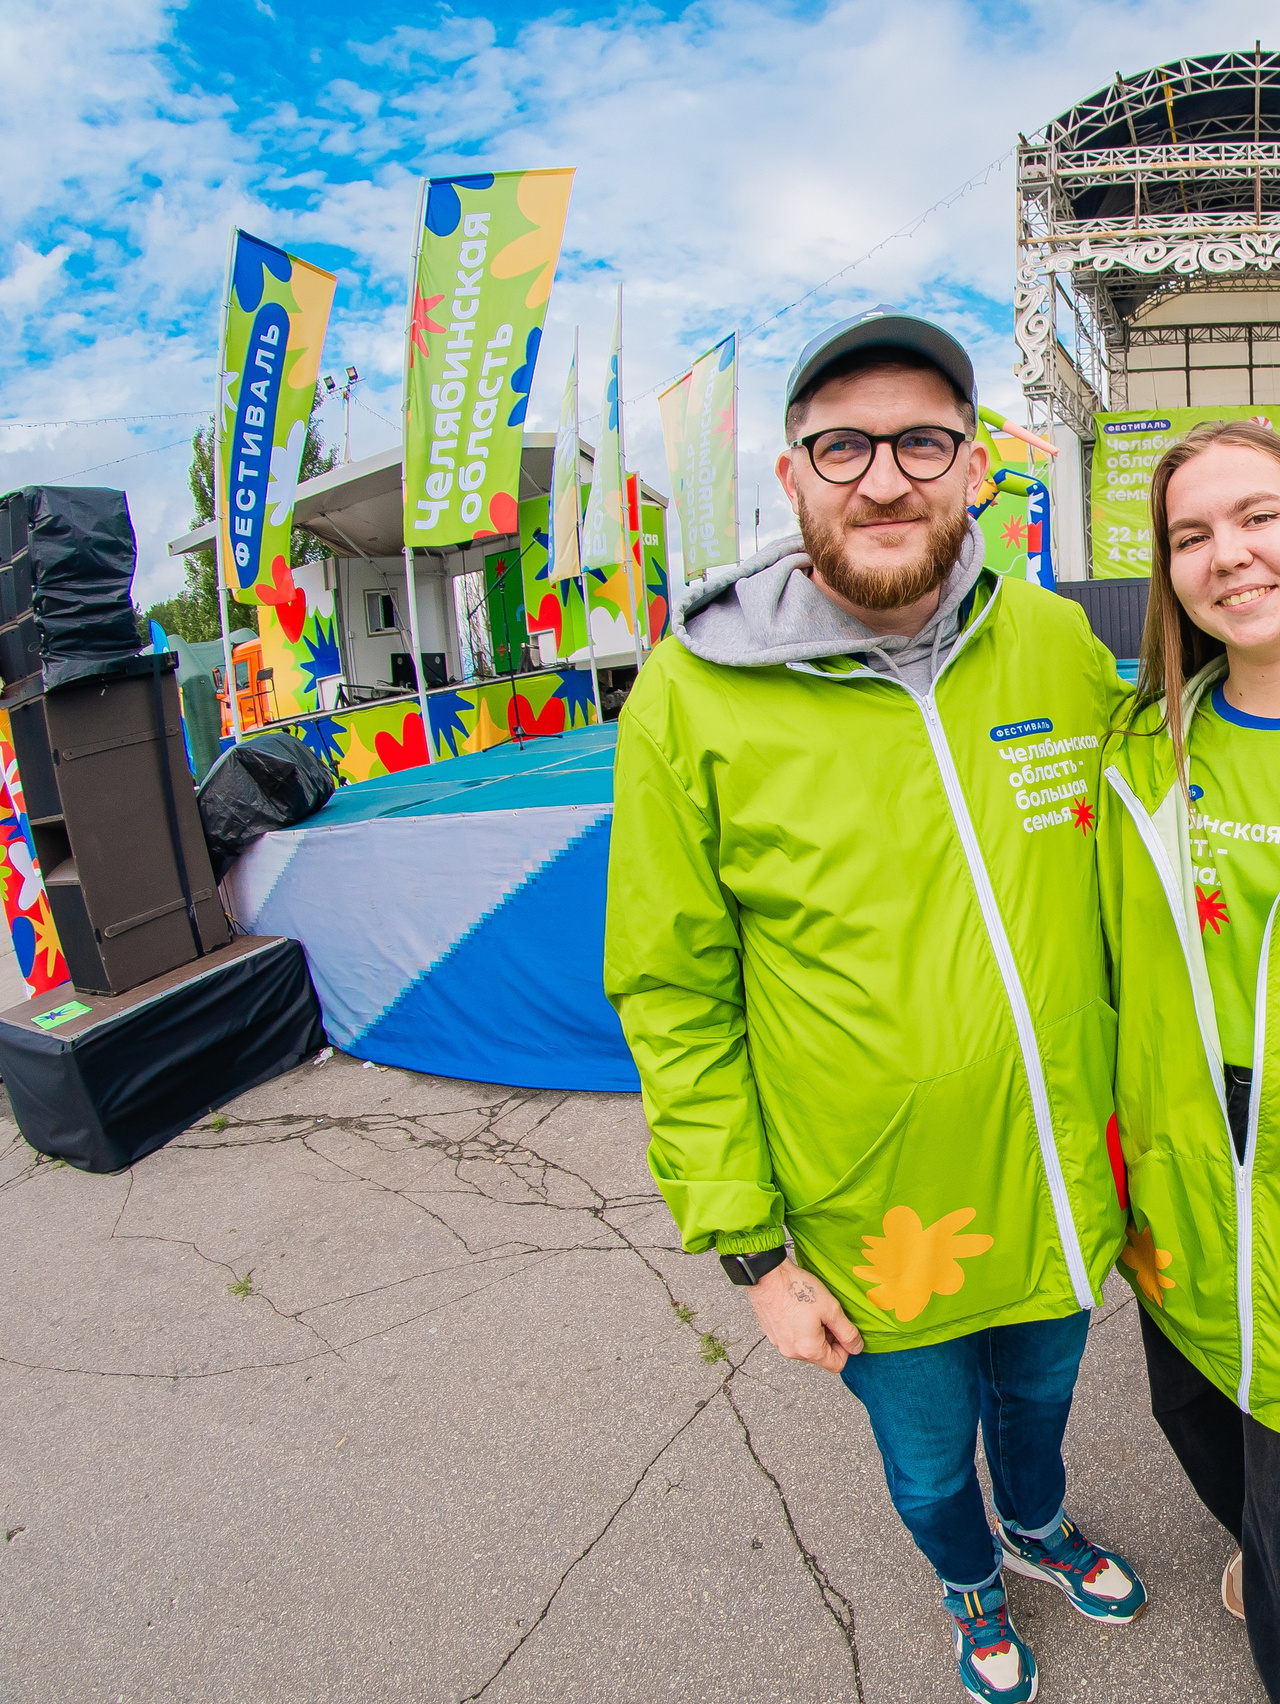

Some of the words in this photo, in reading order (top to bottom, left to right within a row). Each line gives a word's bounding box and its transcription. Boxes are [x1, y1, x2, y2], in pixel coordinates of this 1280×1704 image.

[414, 212, 491, 530] Челябинская
[459, 323, 514, 524] область
[1107, 421, 1167, 432] ФЕСТИВАЛЬ
[234, 324, 280, 567] ФЕСТИВАЛЬ
[1106, 435, 1181, 451] Челяби
[1107, 471, 1151, 485] боль
[1107, 489, 1150, 502] семь
[1107, 527, 1131, 543] 22
[1108, 546, 1121, 562] 4
[996, 721, 1051, 737] ФЕСТИВАЛЬ
[999, 735, 1100, 764] Челябинская
[1015, 779, 1088, 810] большая
[1023, 806, 1073, 833] семья
